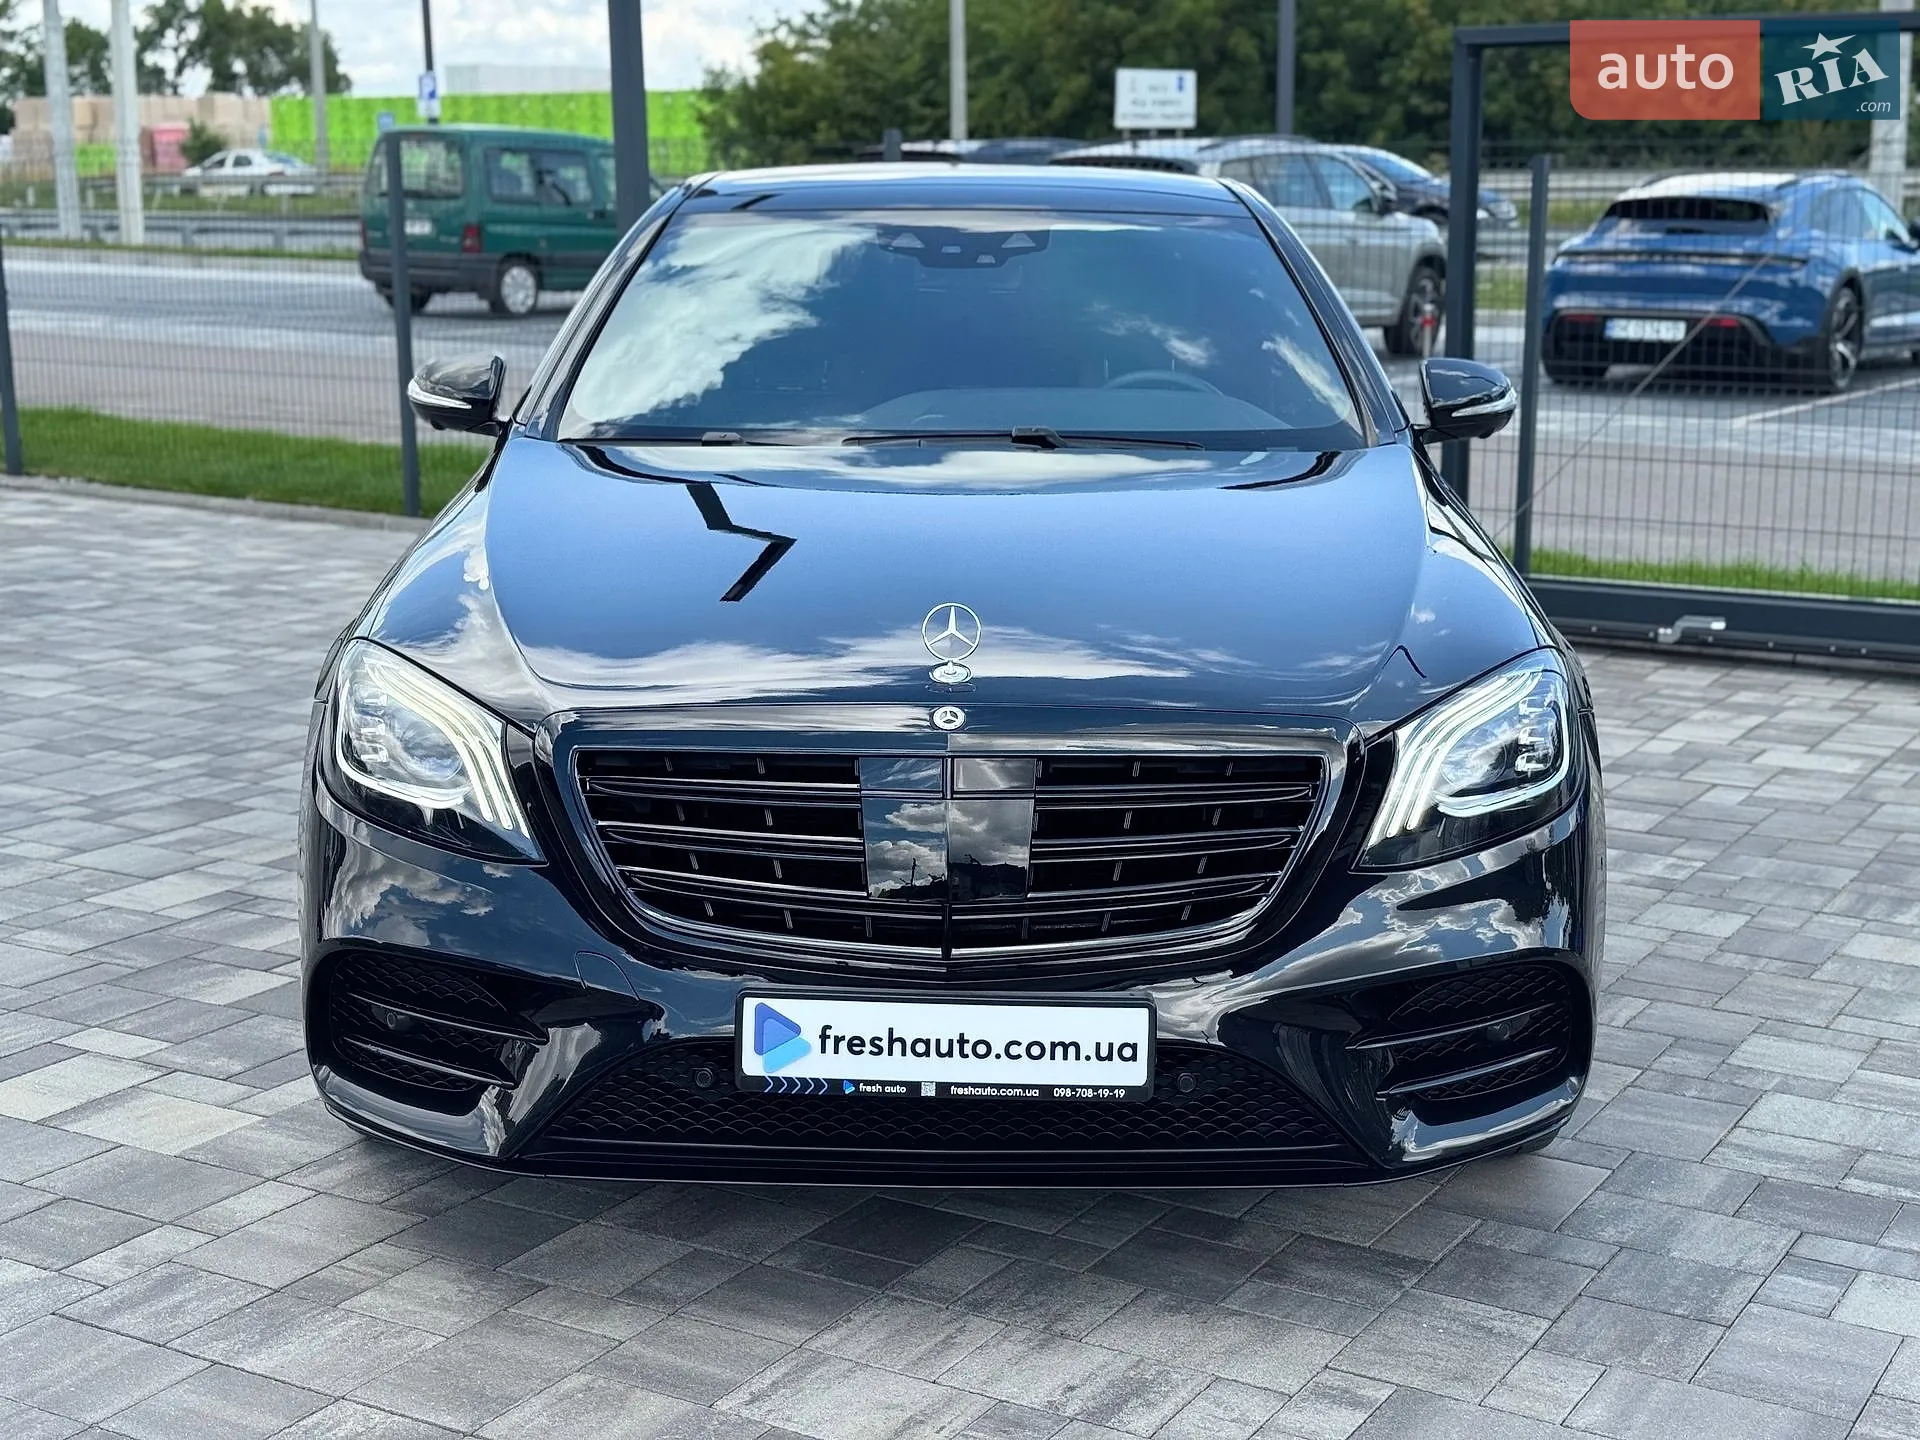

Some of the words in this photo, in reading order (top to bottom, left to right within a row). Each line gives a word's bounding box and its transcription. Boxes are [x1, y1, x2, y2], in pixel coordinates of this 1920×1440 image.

[819, 1024, 1138, 1063] freshauto.com.ua
[859, 1083, 883, 1094] fresh
[884, 1084, 907, 1094] auto
[950, 1085, 1040, 1097] freshauto.com.ua
[1053, 1087, 1126, 1099] 098-708-19-19
